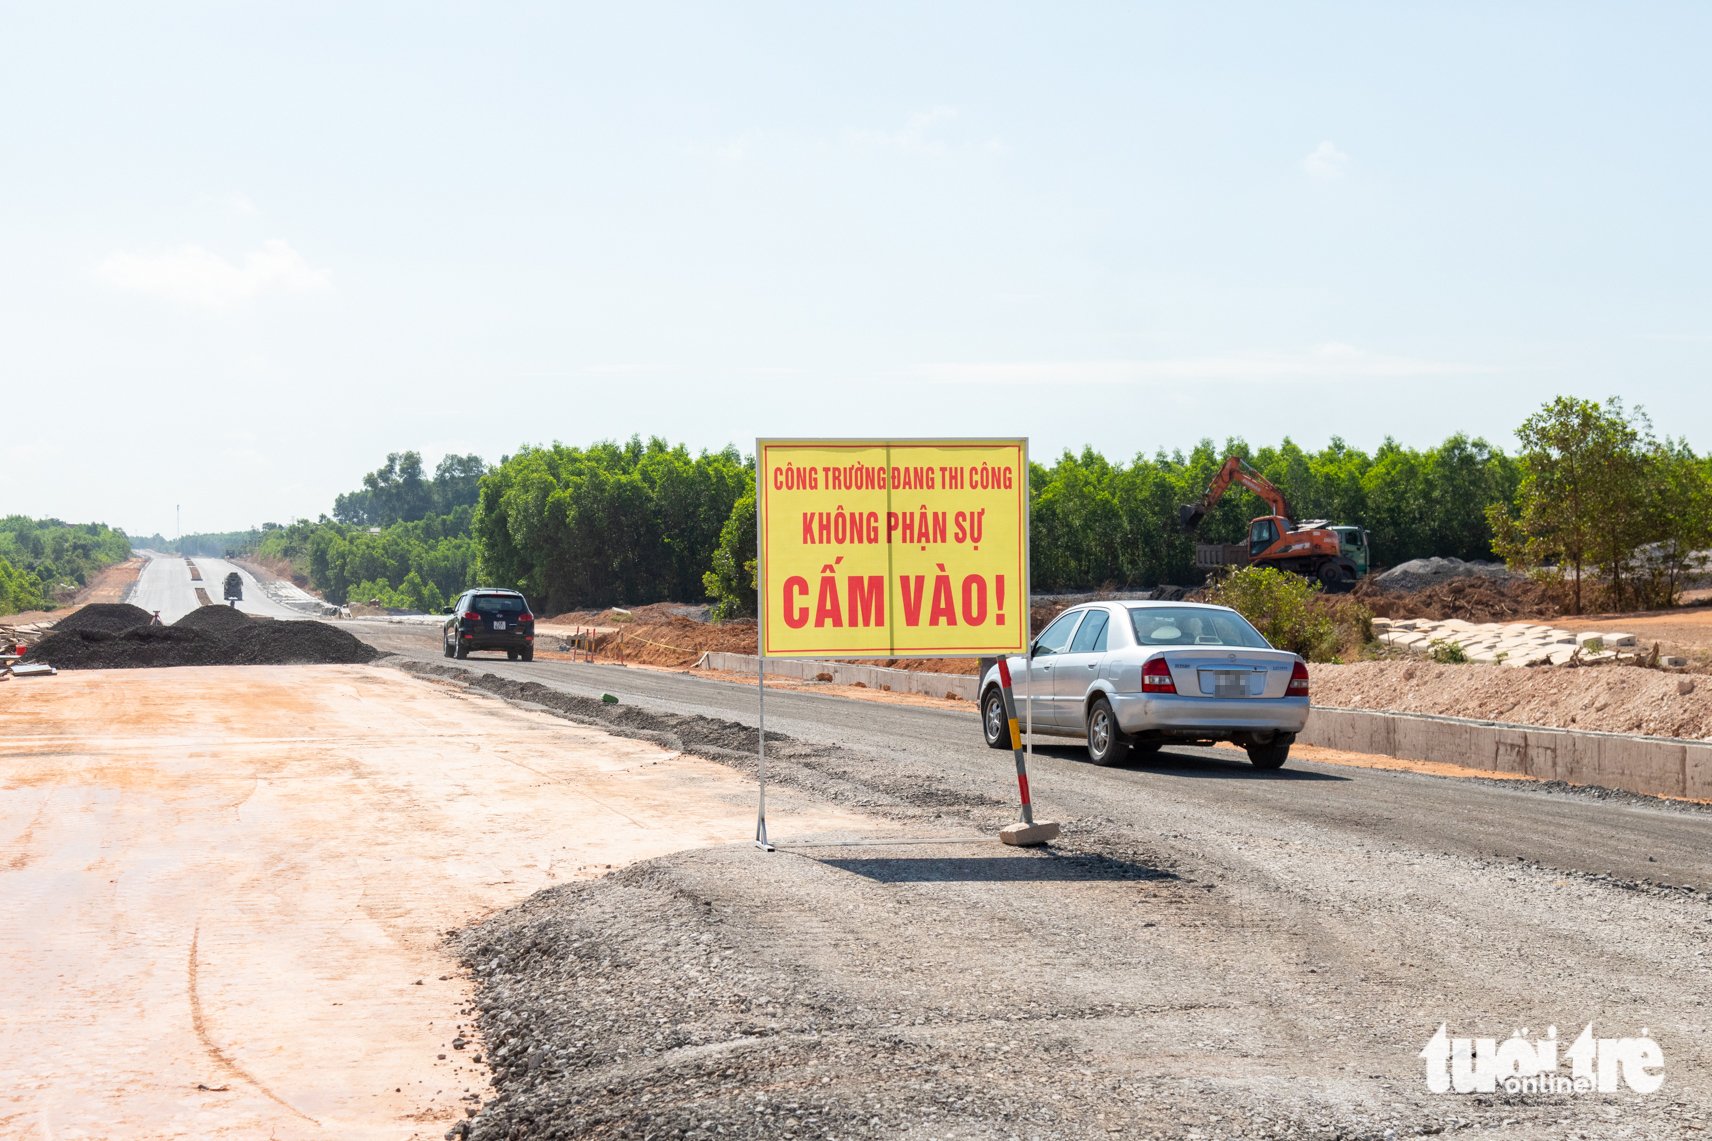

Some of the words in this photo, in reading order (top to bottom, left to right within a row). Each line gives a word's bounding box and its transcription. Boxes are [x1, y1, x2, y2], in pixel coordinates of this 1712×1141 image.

[773, 461, 819, 491] CÔNG
[822, 460, 887, 491] TRƯỜNG
[890, 466, 935, 490] ĐANG
[939, 466, 965, 490] THI
[968, 461, 1013, 490] CÔNG
[802, 504, 879, 545] KHÔNG
[885, 504, 947, 551] PHẬN
[953, 507, 986, 551] SỰ
[782, 555, 885, 630] CẤM
[899, 562, 1006, 627] VÀO!
